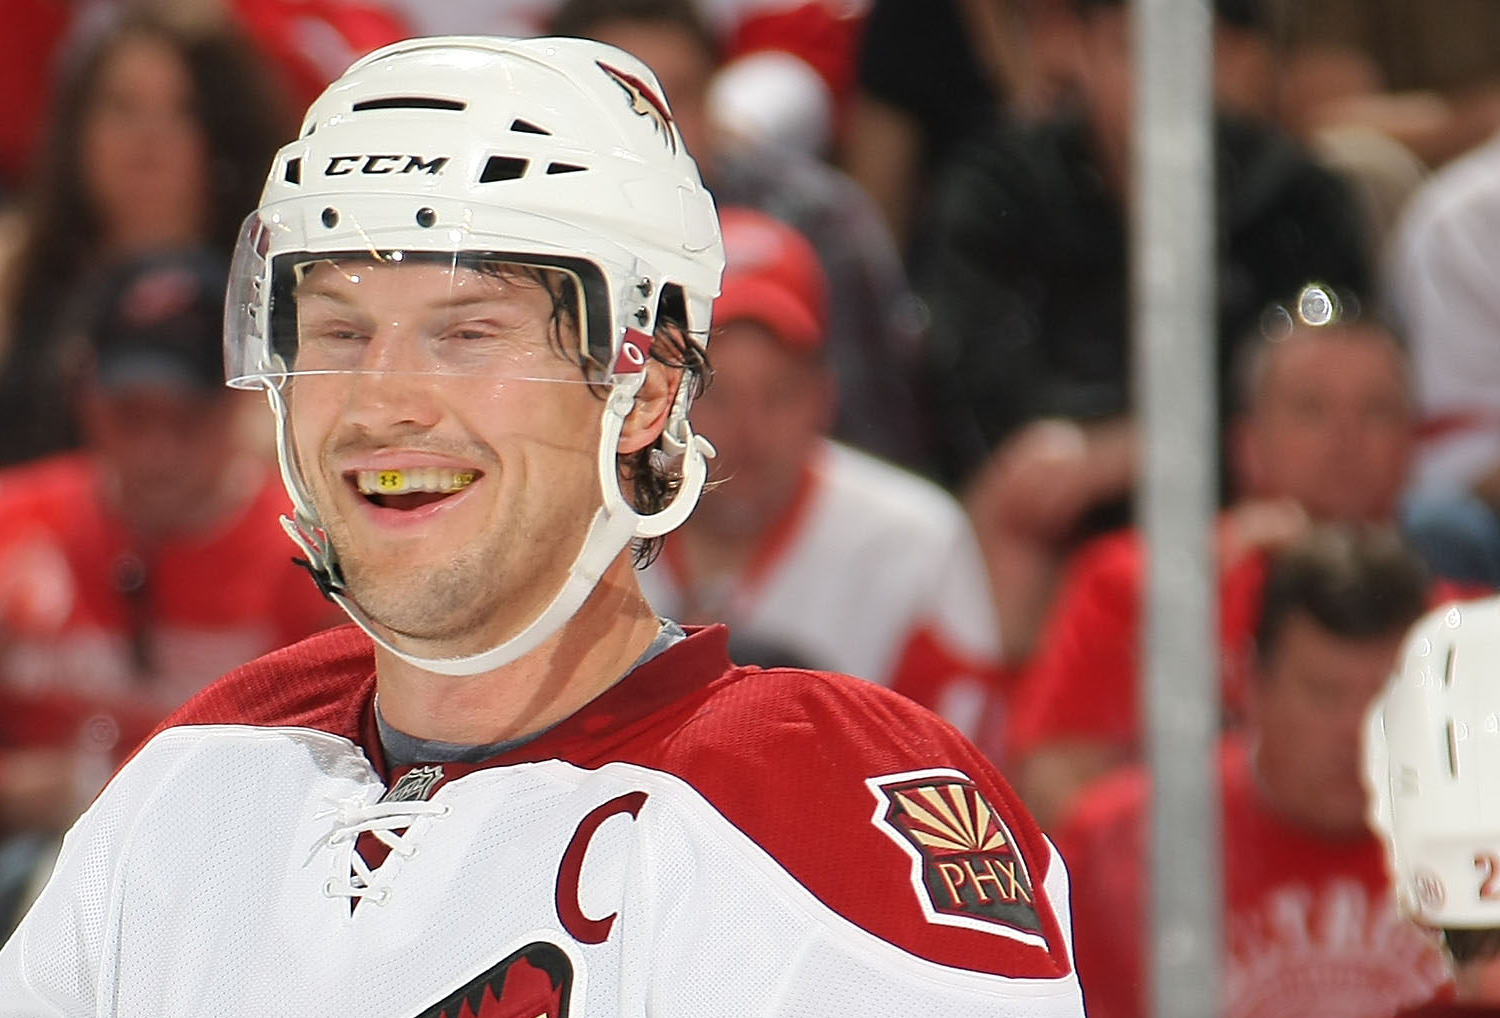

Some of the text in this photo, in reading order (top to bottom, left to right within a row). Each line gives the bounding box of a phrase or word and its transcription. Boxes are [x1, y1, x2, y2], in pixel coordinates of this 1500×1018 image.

[325, 154, 450, 176] CCM
[555, 790, 649, 945] C
[938, 858, 1033, 905] PHX
